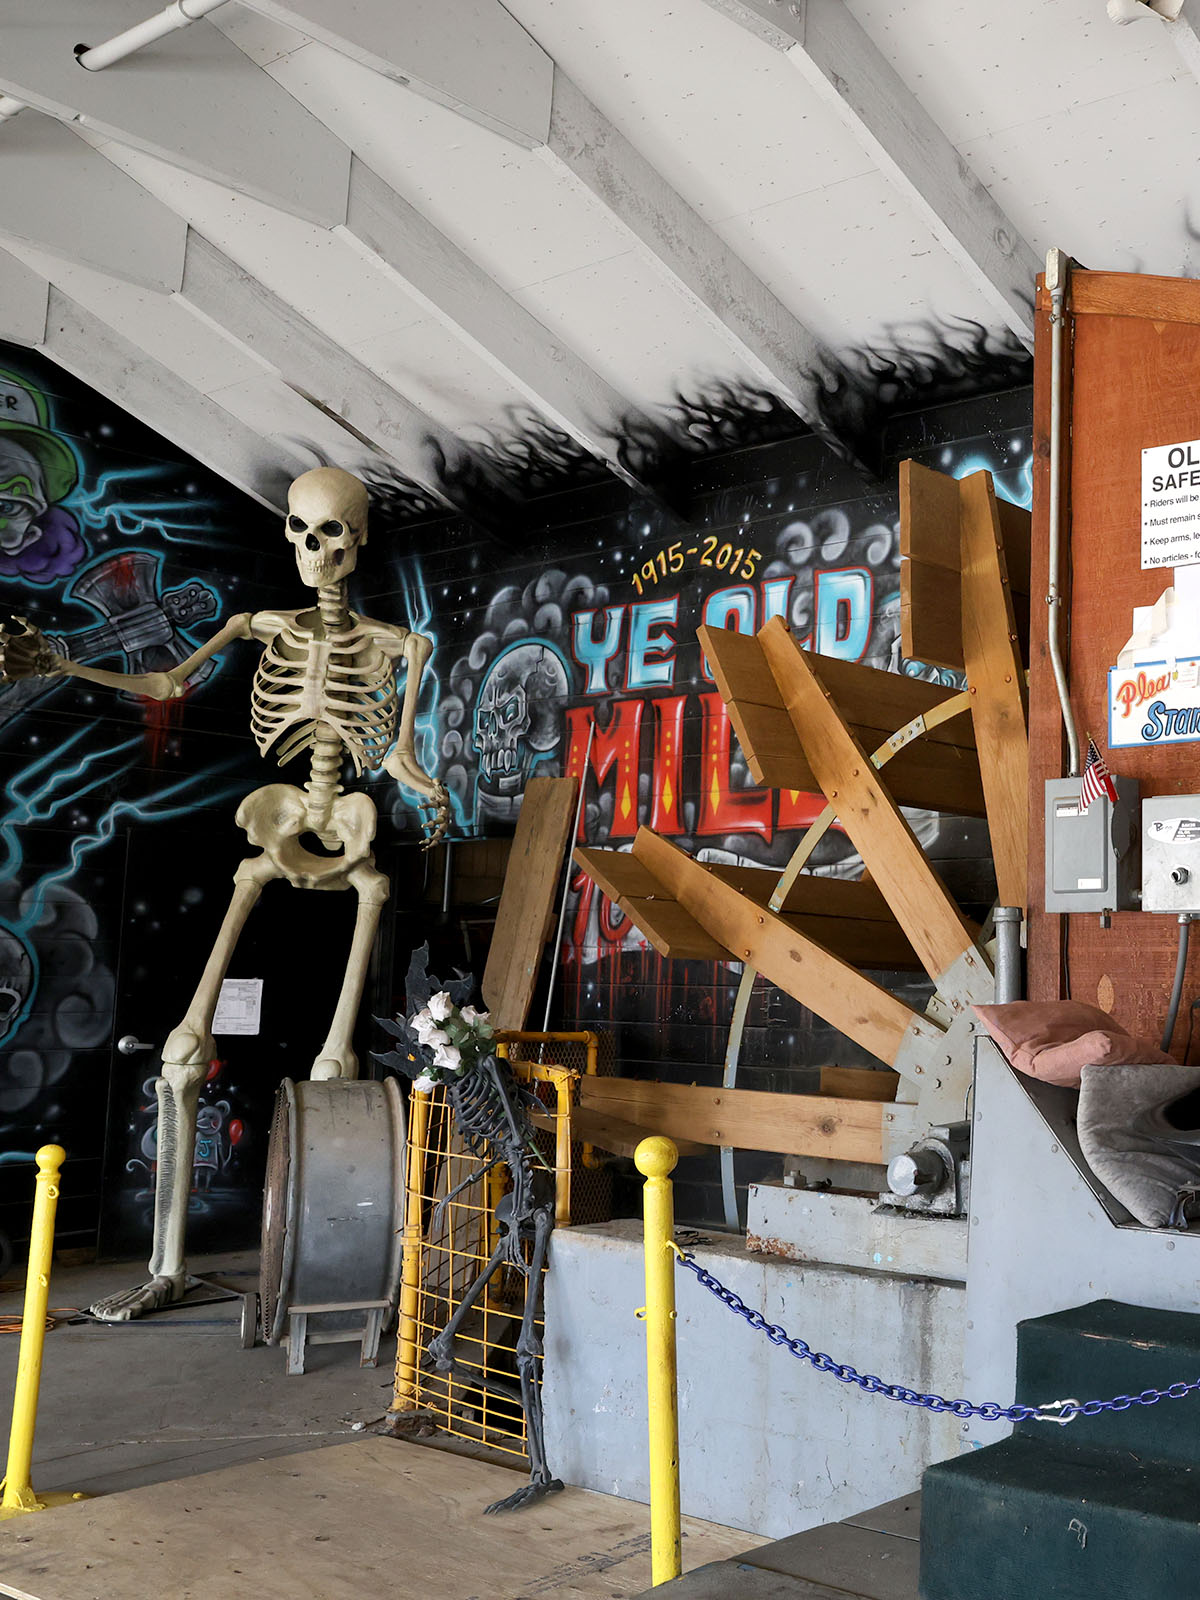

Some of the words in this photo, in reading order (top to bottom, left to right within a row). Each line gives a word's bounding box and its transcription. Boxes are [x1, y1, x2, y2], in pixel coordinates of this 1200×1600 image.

[1150, 496, 1174, 508] Riders
[1176, 492, 1188, 503] will
[1190, 492, 1200, 502] be
[1150, 516, 1168, 526] Must
[1170, 512, 1196, 524] remain
[1150, 536, 1169, 547] Keep
[1170, 534, 1192, 544] arms,
[632, 536, 762, 595] 1915-2015
[1150, 556, 1160, 565] No
[1162, 552, 1188, 564] articles
[571, 593, 680, 696] YE
[200, 1140, 213, 1158] J
